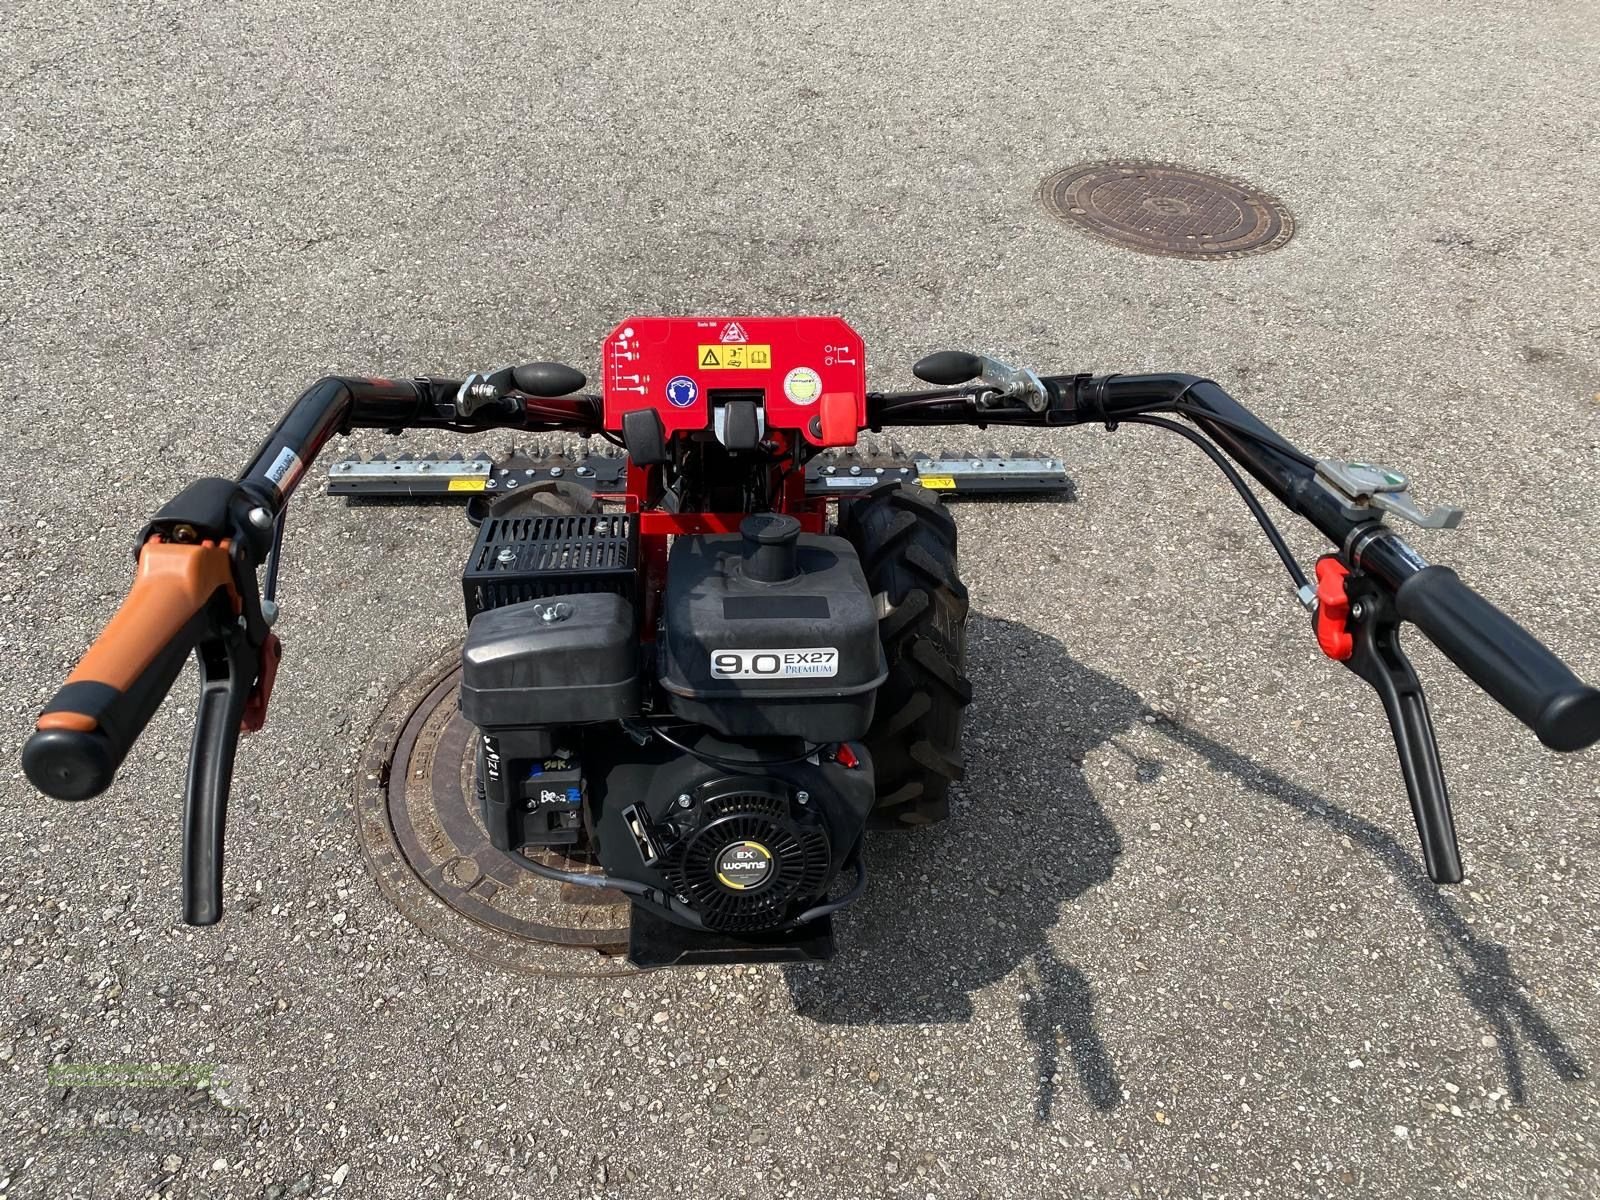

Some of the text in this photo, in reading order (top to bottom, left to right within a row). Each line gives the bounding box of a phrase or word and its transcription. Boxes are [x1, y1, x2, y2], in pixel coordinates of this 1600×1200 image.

[714, 653, 781, 674] 9.0
[784, 652, 836, 664] EX27
[784, 664, 833, 675] PREMIUM
[736, 851, 754, 859] EX
